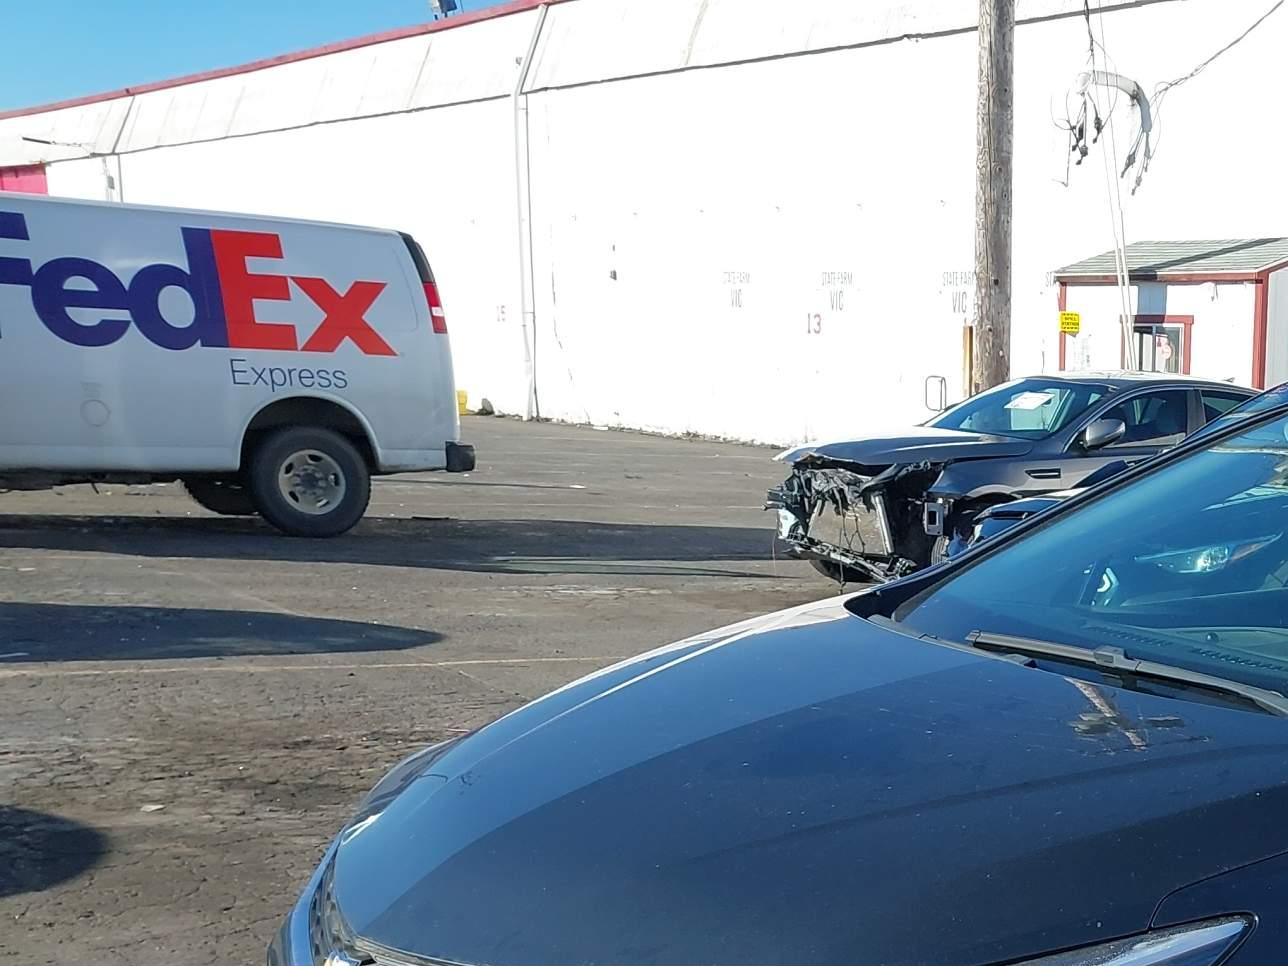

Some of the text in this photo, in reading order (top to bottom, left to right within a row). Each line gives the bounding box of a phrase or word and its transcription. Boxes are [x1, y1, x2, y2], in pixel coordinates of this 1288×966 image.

[829, 288, 844, 312] VIC
[952, 291, 967, 314] VIC
[807, 312, 822, 335] 13
[229, 358, 348, 391] Express
